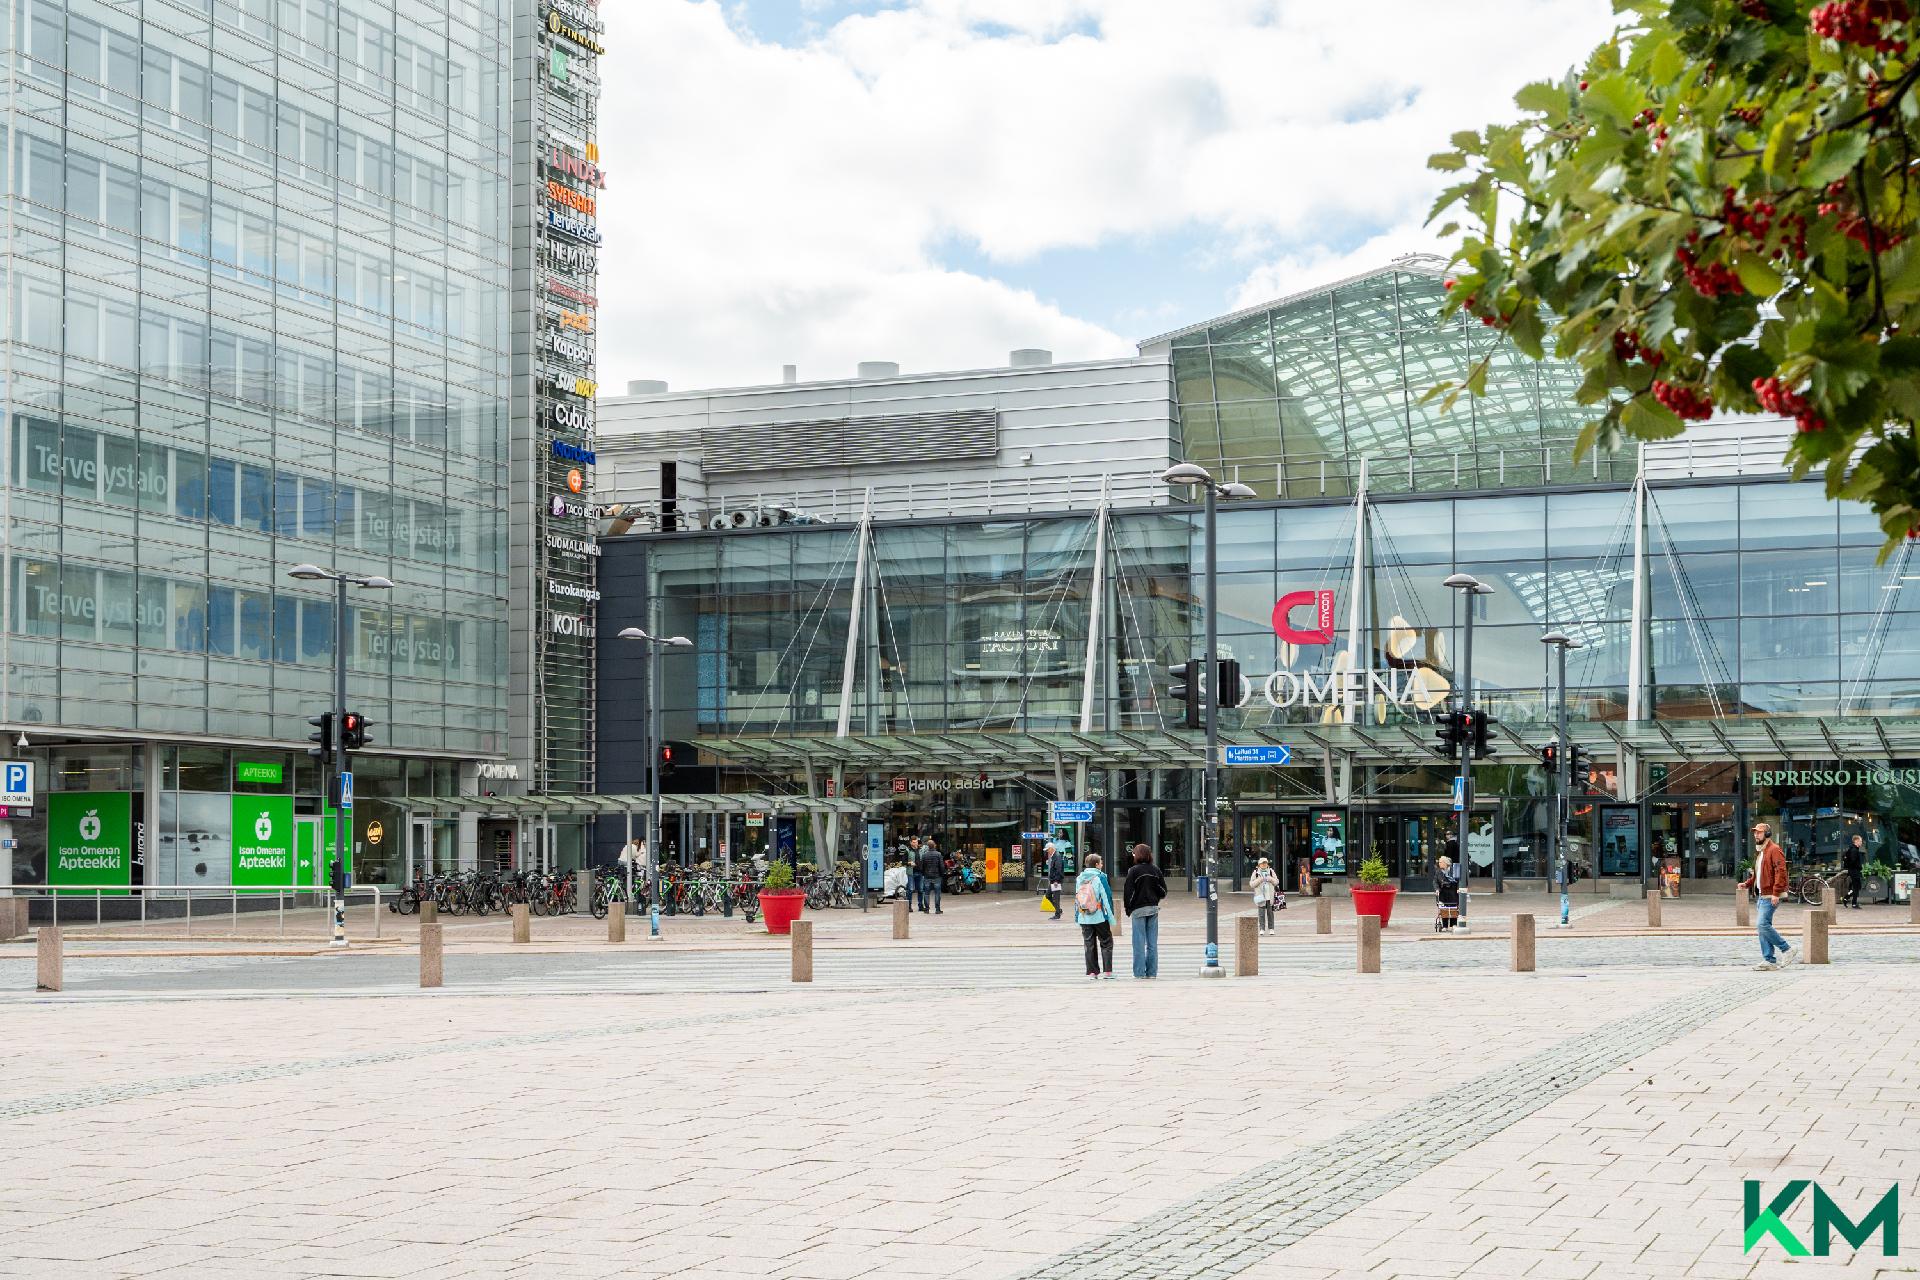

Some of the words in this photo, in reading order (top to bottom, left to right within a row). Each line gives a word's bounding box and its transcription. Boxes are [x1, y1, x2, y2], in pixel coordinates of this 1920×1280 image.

[553, 142, 607, 189] LINDEX
[551, 239, 600, 275] HEMTEX
[556, 371, 599, 398] SUBWAY
[556, 403, 594, 432] Cubus
[566, 503, 583, 516] TACO
[546, 534, 602, 556] SUOMALAINEN
[549, 579, 600, 602] Eurokangas
[1265, 667, 1433, 708] OMENA
[10, 766, 24, 791] P
[1752, 770, 1850, 786] ESPRESSO
[1855, 769, 1920, 786] HOUS
[59, 846, 79, 855] Ison
[81, 846, 120, 855] Omenan
[239, 846, 256, 855] Ison
[256, 846, 286, 855] Omenan
[58, 856, 121, 871] Apteekki
[239, 856, 286, 869] Apteekki
